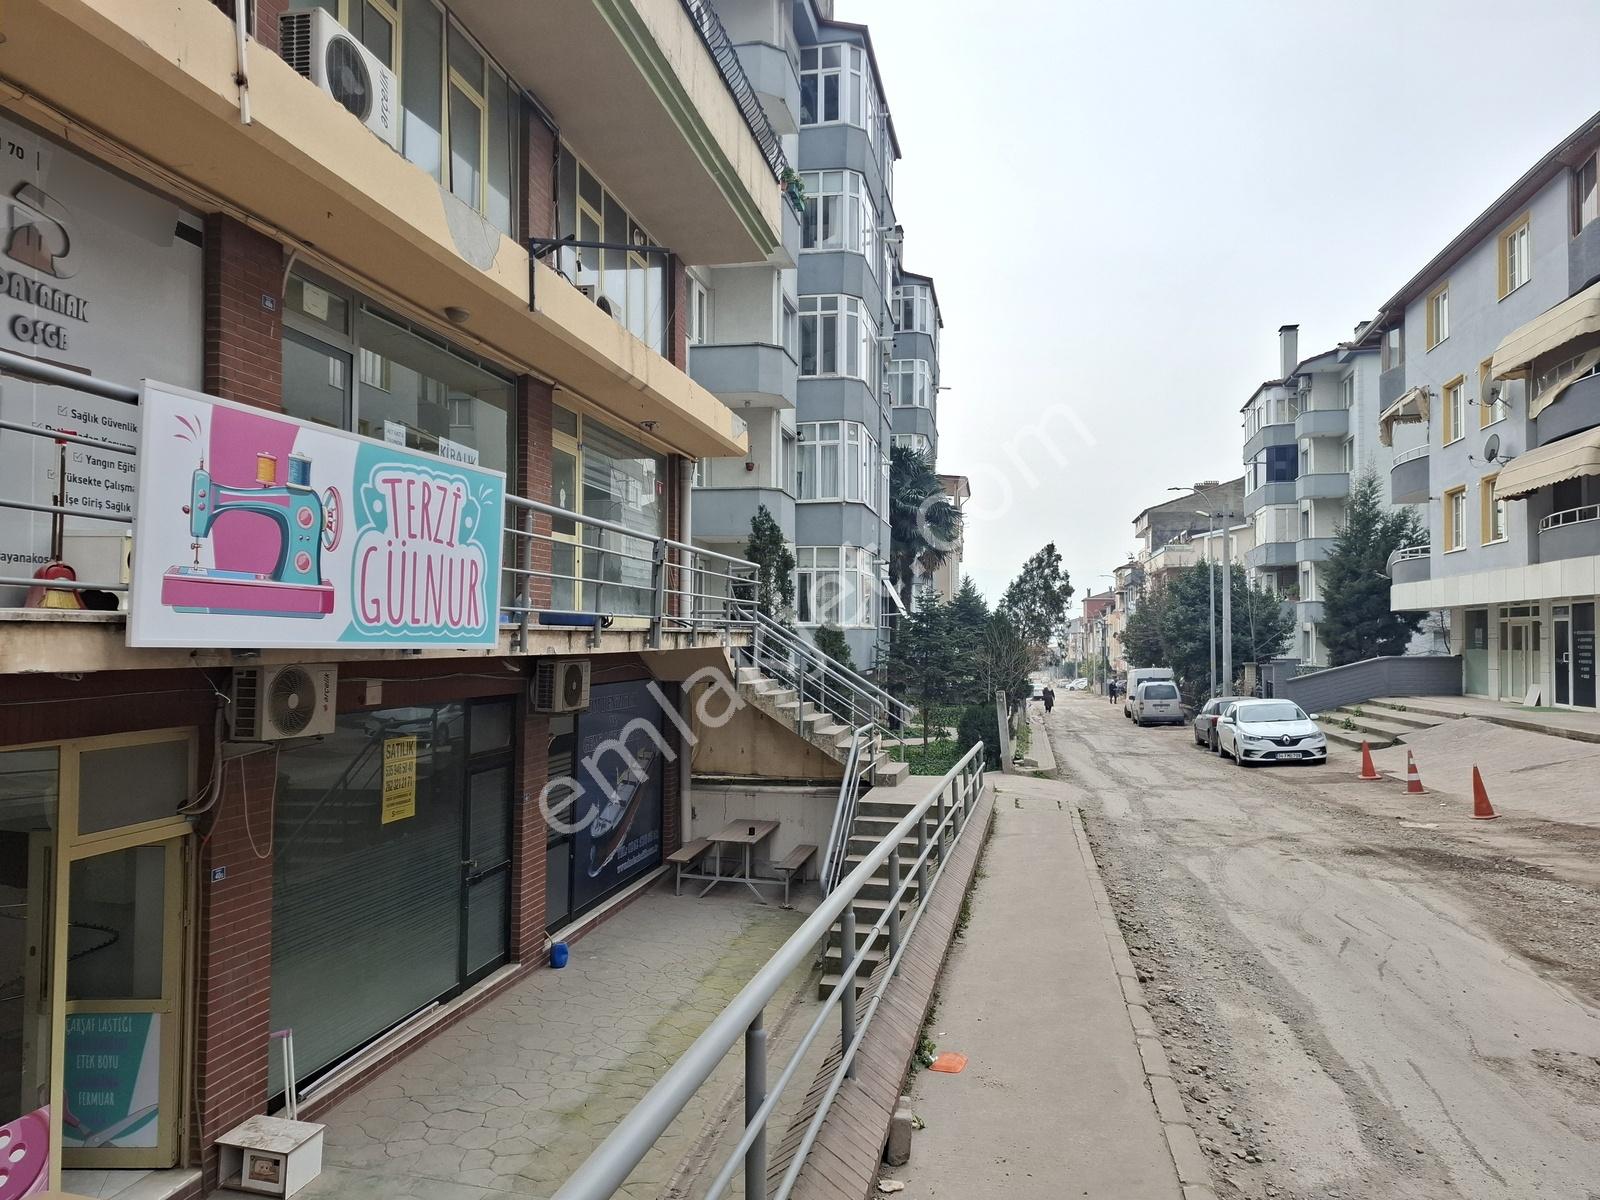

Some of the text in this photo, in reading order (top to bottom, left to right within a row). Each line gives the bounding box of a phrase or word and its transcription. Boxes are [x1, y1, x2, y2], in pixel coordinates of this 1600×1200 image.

[71, 408, 138, 433] Sağlık Güvenlik
[85, 454, 115, 469] Yangın
[63, 472, 102, 487] üksekte
[81, 496, 103, 509] Giriş
[105, 500, 132, 513] Sağlık
[381, 478, 462, 549] TERZİ
[360, 540, 480, 628] GÜLNUR
[385, 740, 414, 759] SATILIK
[76, 1054, 119, 1069] ETEK BOYU
[78, 1091, 115, 1106] FERMUAR
